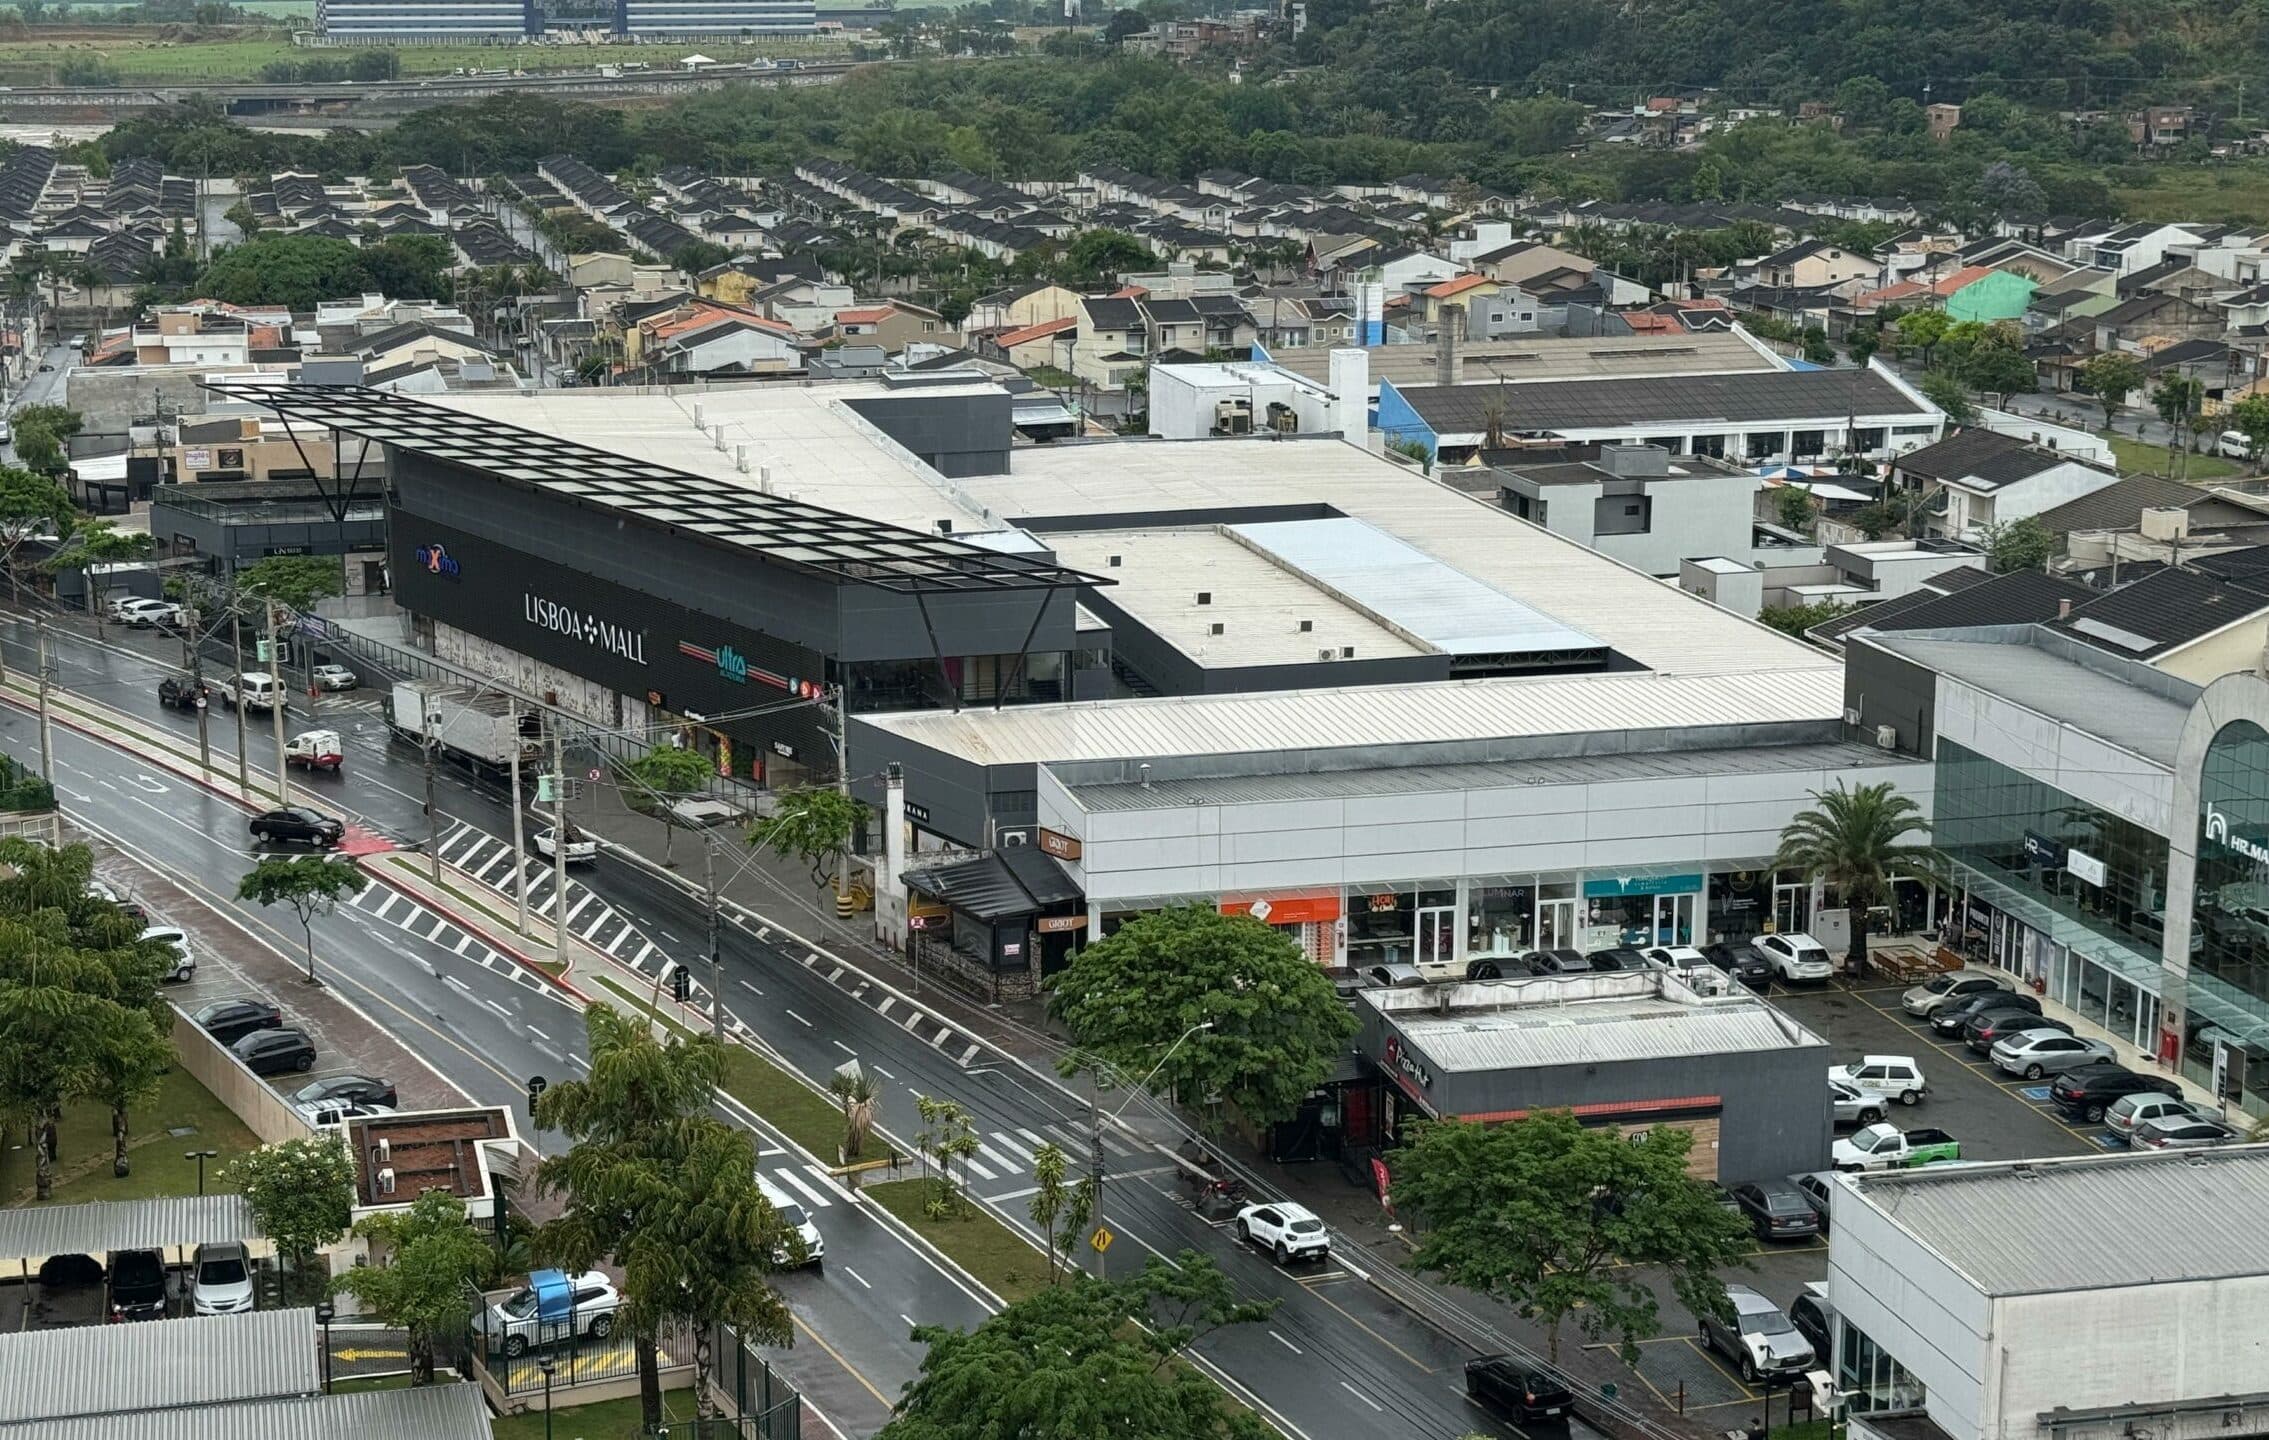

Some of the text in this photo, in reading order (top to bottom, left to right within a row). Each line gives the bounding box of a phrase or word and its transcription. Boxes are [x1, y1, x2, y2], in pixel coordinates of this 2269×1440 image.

[525, 593, 648, 665] LISBOA MALL
[716, 645, 746, 676] ultra
